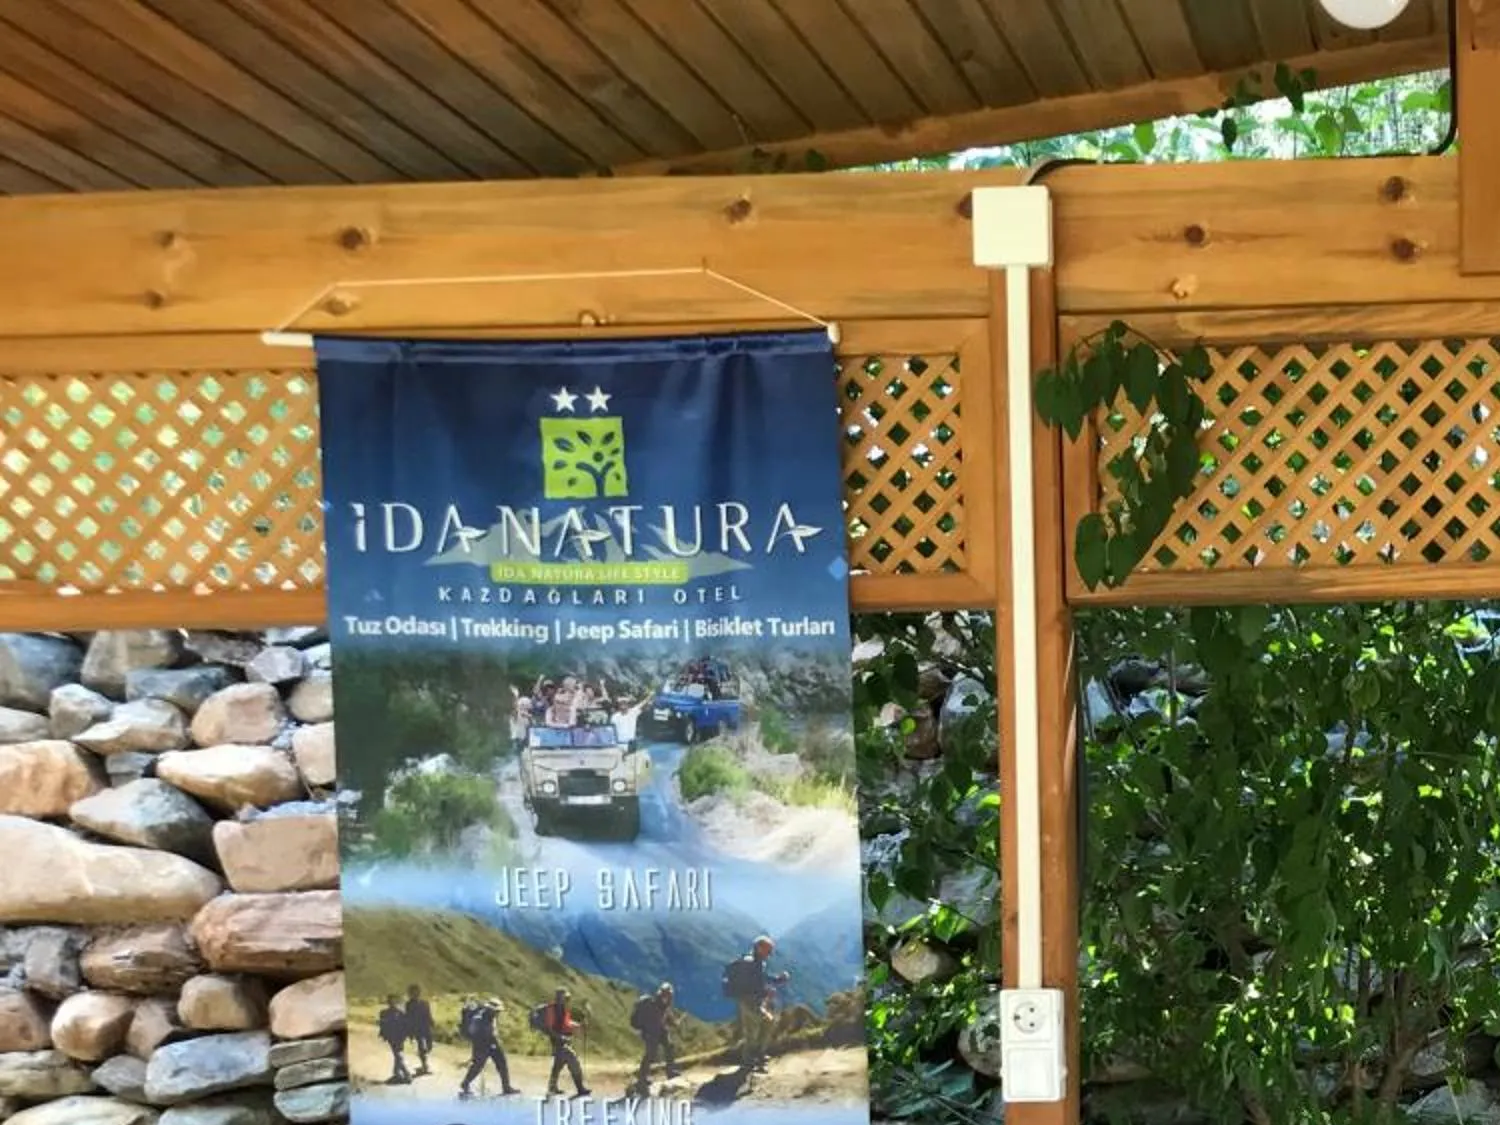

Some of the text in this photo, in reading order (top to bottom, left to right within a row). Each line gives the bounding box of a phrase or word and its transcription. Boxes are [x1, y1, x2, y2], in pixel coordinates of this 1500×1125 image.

[496, 502, 824, 557] NATURA
[438, 585, 742, 605] KAZDAĞLARI OTEL
[343, 616, 382, 636] Tuz
[384, 616, 447, 636] Odası
[460, 618, 549, 644] Trekking
[565, 619, 615, 644] Jeep
[618, 619, 679, 639] Safari
[695, 616, 763, 637] Bisiklet
[766, 616, 836, 637] Turları
[495, 865, 712, 910] JEEP SAFARI
